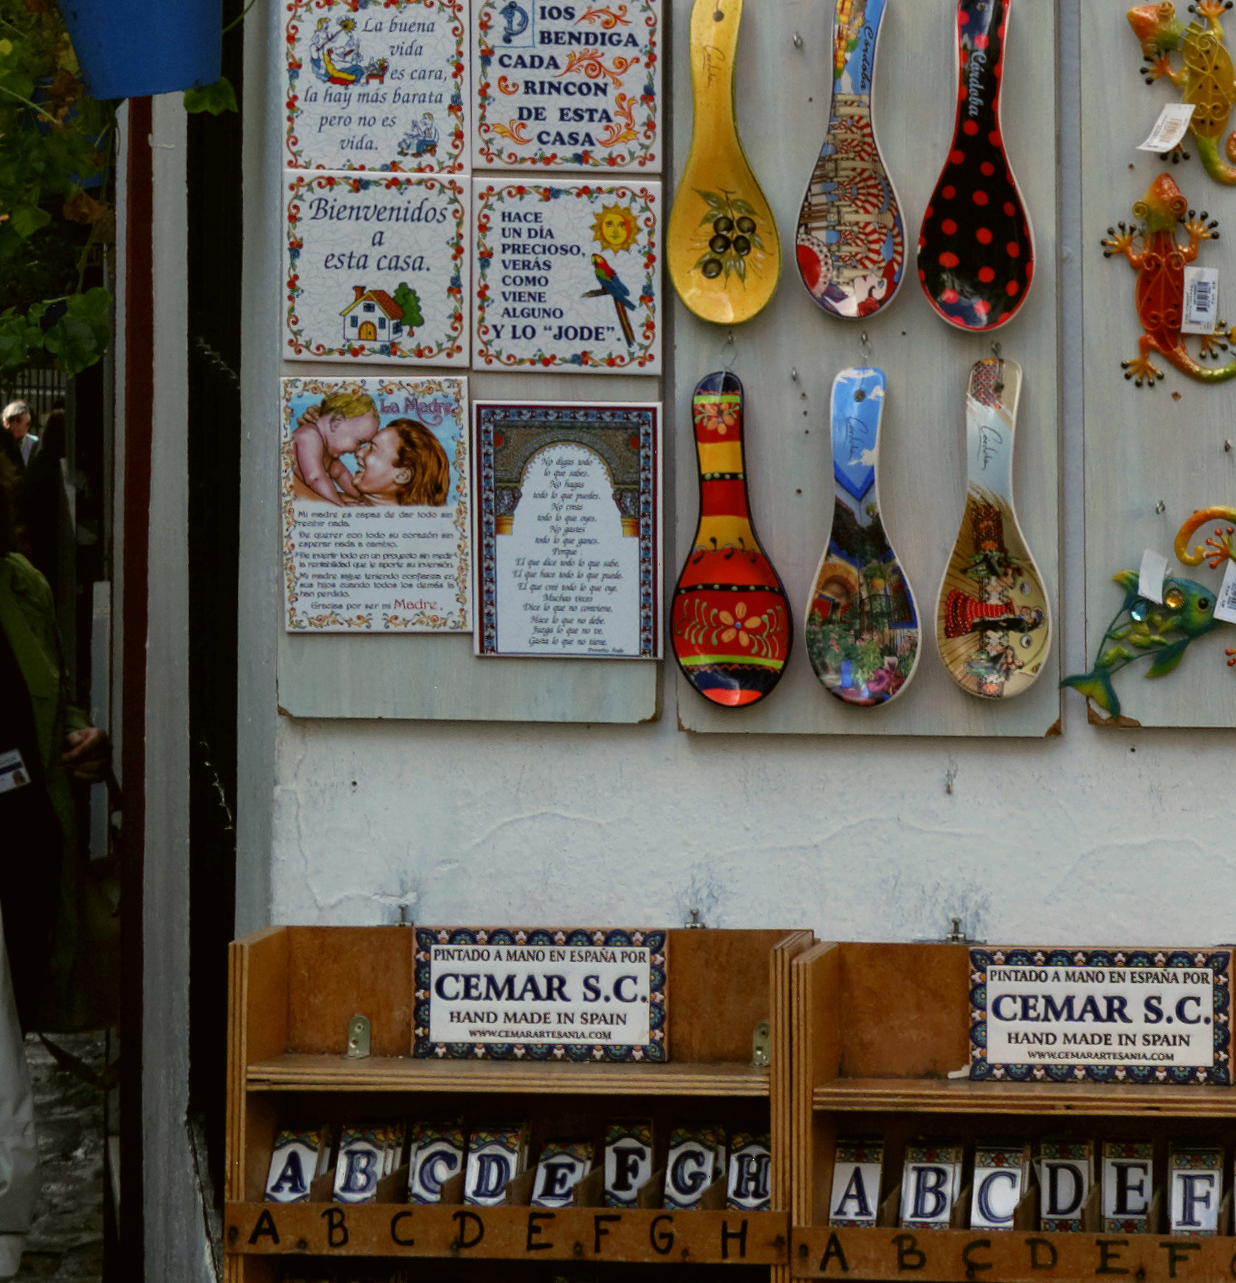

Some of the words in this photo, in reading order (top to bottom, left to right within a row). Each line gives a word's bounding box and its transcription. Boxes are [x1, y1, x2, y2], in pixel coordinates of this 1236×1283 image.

[362, 18, 383, 32] La
[389, 16, 435, 33] buena
[539, 31, 639, 47] BENDIGA
[390, 40, 423, 56] vida
[498, 54, 560, 69] CADA
[391, 68, 404, 80] es
[411, 69, 447, 82] cara,
[523, 81, 608, 96] RINCON
[304, 86, 318, 102] la
[324, 86, 352, 109] hay
[357, 88, 388, 104] más
[393, 87, 443, 104] barata
[518, 107, 546, 121] DE
[558, 107, 613, 123] ESTA
[318, 116, 352, 132] pero
[358, 116, 376, 127] no
[382, 116, 397, 127] es
[340, 134, 378, 150] vida.
[537, 131, 596, 146] CASA
[309, 197, 448, 223] Bienvenidos
[501, 212, 543, 223] HACE
[372, 231, 384, 247] a
[502, 228, 521, 238] UN
[527, 226, 554, 239] DÍA
[502, 244, 586, 256] PRECIOSO,
[324, 251, 369, 269] esta
[376, 255, 430, 271] casa.
[501, 257, 552, 271] VERÁS
[502, 275, 549, 286] COMO
[501, 292, 546, 302] VIENE
[501, 308, 564, 318] ALGUNO
[492, 325, 504, 339] Y
[511, 325, 536, 339] LO
[434, 950, 490, 961] PINTADO
[494, 950, 503, 961] A
[506, 950, 545, 962] MANO
[550, 950, 566, 962] EN
[570, 948, 617, 963] ESPAÑA
[621, 951, 647, 963] POR
[990, 970, 1048, 982] PINTADO
[1051, 971, 1060, 982] A
[1065, 971, 1105, 983] MANO
[1110, 971, 1126, 983] EN
[1130, 969, 1179, 984] ESPAÑA
[1183, 972, 1210, 984] POR
[435, 973, 571, 1001] CEMAR
[583, 975, 648, 1003] S.C.
[992, 994, 1132, 1023] CEMAR
[1144, 996, 1211, 1025] S.C.
[449, 1012, 498, 1023] HAND
[504, 1012, 551, 1024] MADE
[557, 1013, 575, 1024] IN
[581, 1013, 627, 1025] SPAIN
[1007, 1033, 1057, 1045] HAND
[1063, 1033, 1112, 1046] MADE
[1118, 1034, 1136, 1046] IN
[1142, 1034, 1191, 1047] SPAIN
[271, 1150, 307, 1194] A
[340, 1149, 378, 1193] B
[419, 1150, 458, 1194] C
[472, 1154, 510, 1197] D
[538, 1162, 576, 1200] E
[612, 1146, 646, 1191] F
[671, 1150, 707, 1195] G
[733, 1154, 771, 1199] H
[834, 1166, 873, 1216] A
[911, 1166, 948, 1218] B
[978, 1171, 1017, 1223] C
[1046, 1163, 1084, 1215] D
[1111, 1162, 1148, 1215] E
[1176, 1174, 1215, 1227] F
[248, 1209, 280, 1245] A
[321, 1208, 349, 1248] B
[391, 1211, 415, 1246] C
[453, 1211, 484, 1248] D
[527, 1212, 556, 1250] E
[594, 1215, 621, 1253] F
[650, 1215, 674, 1254] G
[721, 1220, 747, 1259] H
